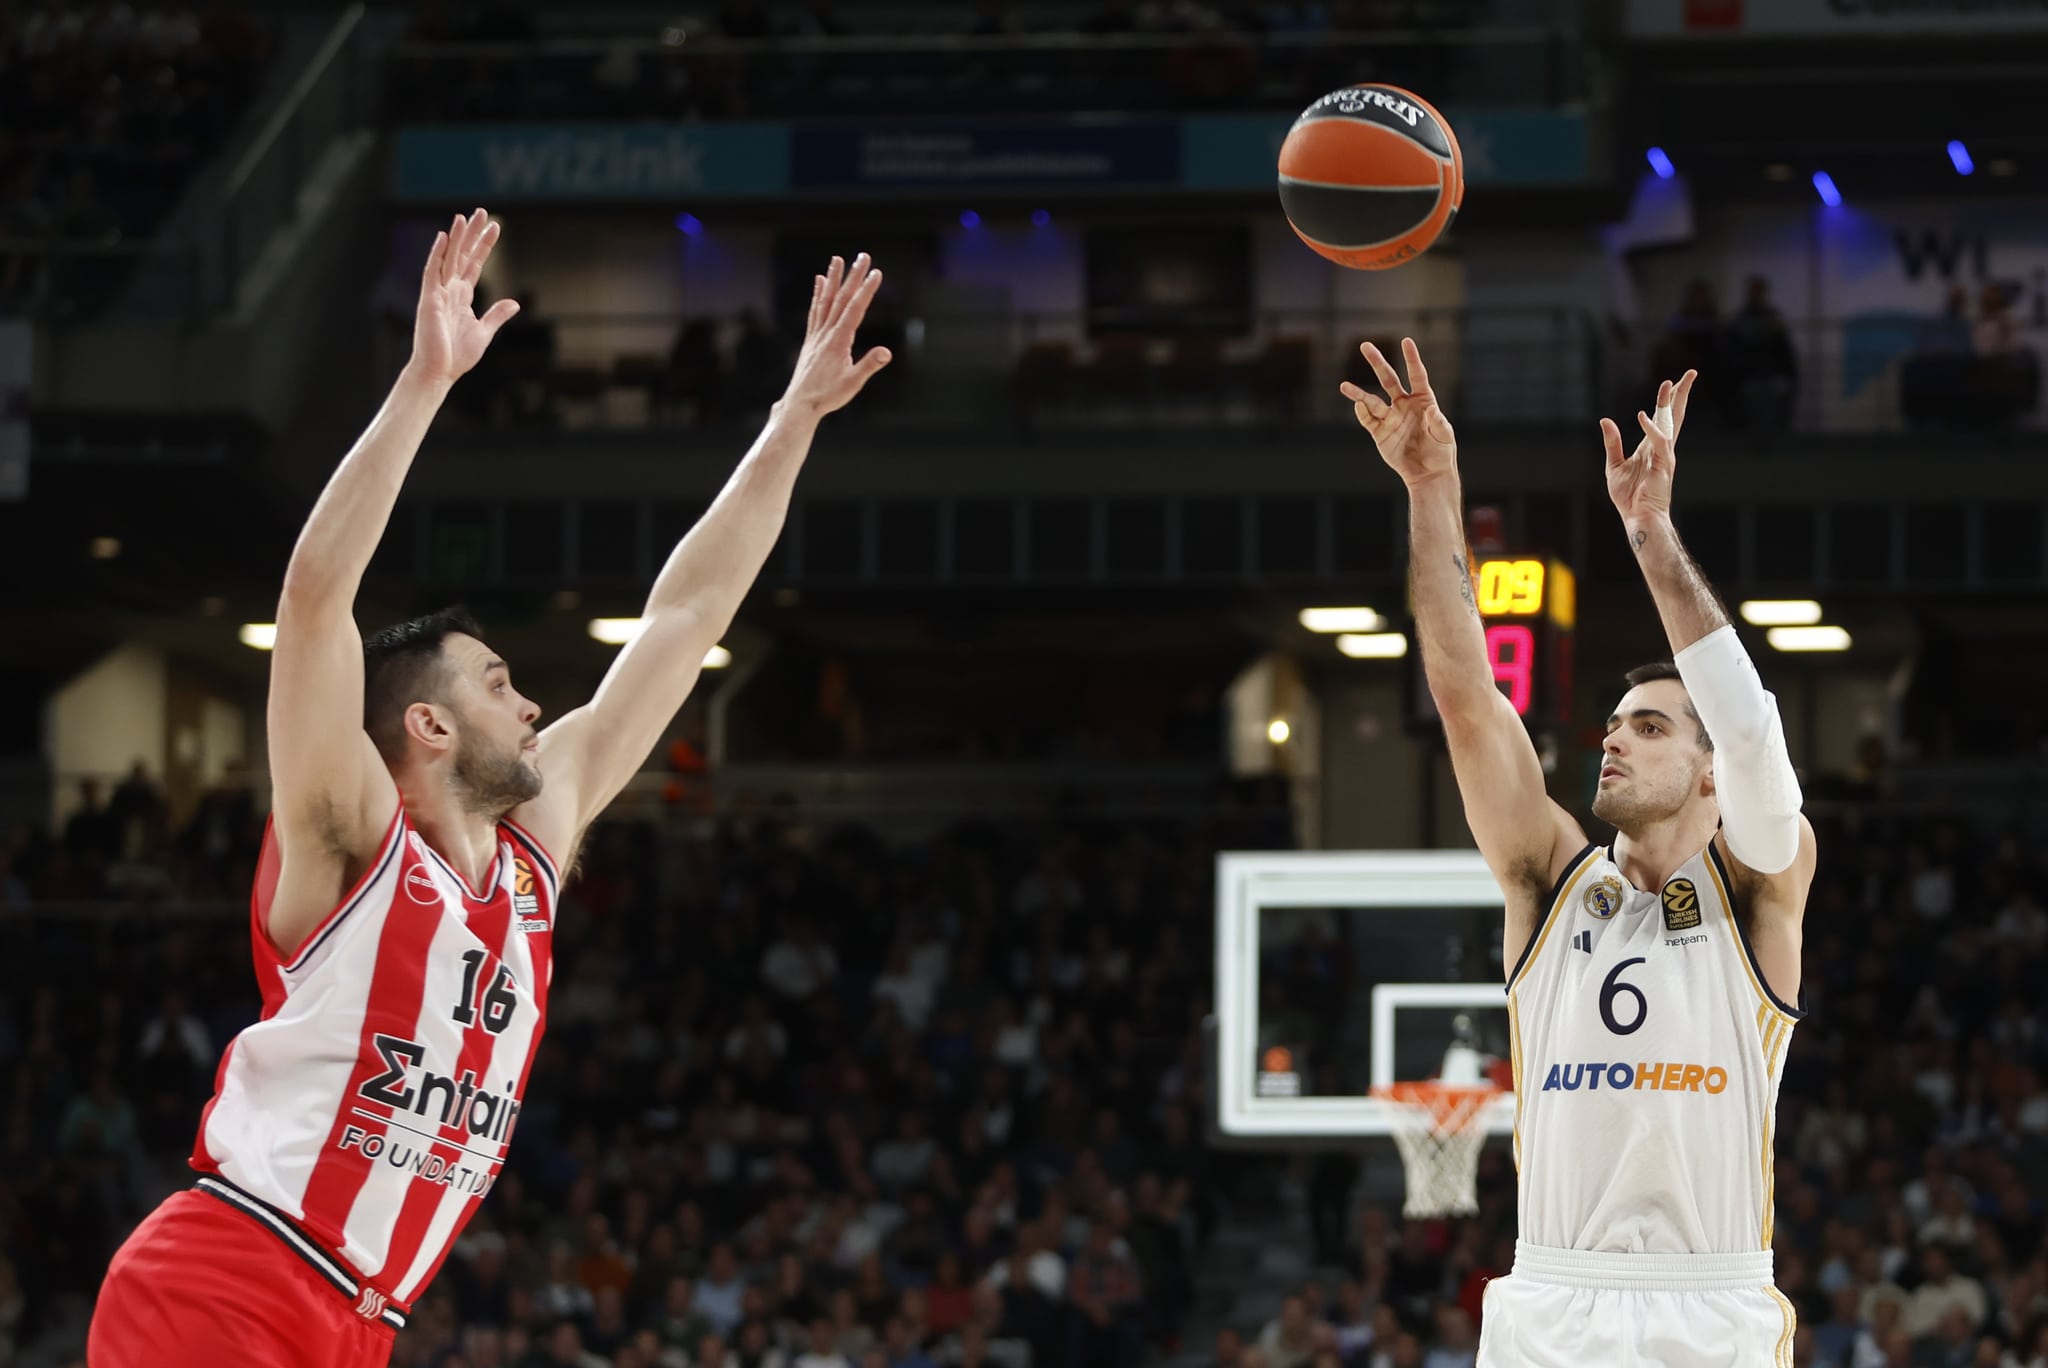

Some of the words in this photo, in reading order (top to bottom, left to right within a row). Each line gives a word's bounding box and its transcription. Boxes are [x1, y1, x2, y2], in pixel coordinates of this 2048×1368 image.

[1478, 560, 1545, 614] 09
[1486, 625, 1534, 715] 9
[453, 949, 518, 1034] 16
[1599, 957, 1648, 1036] 6
[1543, 1063, 1728, 1095] AUTOHERO
[340, 1126, 497, 1198] FOUNDATIO
